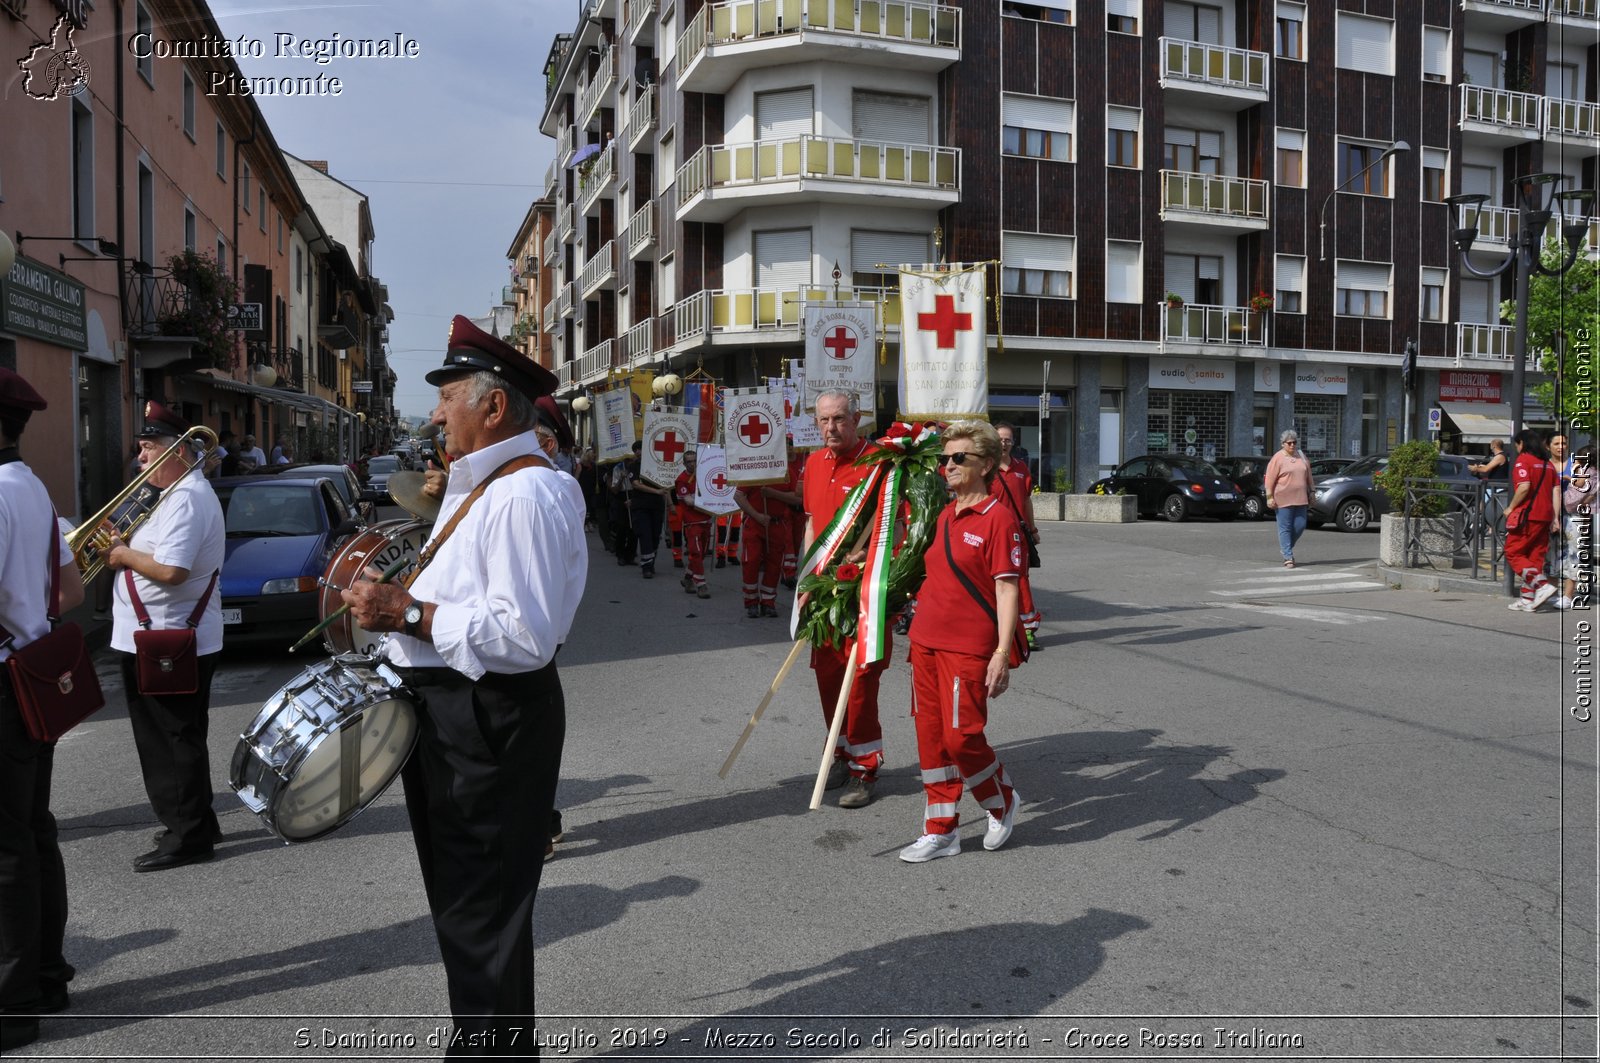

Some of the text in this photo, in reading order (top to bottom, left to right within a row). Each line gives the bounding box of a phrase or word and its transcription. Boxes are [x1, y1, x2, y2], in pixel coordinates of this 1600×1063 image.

[53, 280, 81, 306] GALLINO
[240, 311, 258, 319] BAR
[811, 312, 870, 340] CROCE ROSSA ITALIANA
[829, 365, 853, 373] GRUPPO
[907, 361, 947, 372] COMITATO
[1160, 369, 1225, 379] audio sanitas
[1324, 375, 1346, 383] sanitas
[1449, 372, 1489, 386] MAGAZINE
[807, 379, 873, 390] VILLAFRANCA D'ASTI
[914, 380, 978, 390] SAN DAMIANO
[728, 400, 783, 431] CROCE ROSSA ITALIANA
[729, 461, 768, 471] MONTEGROSSO
